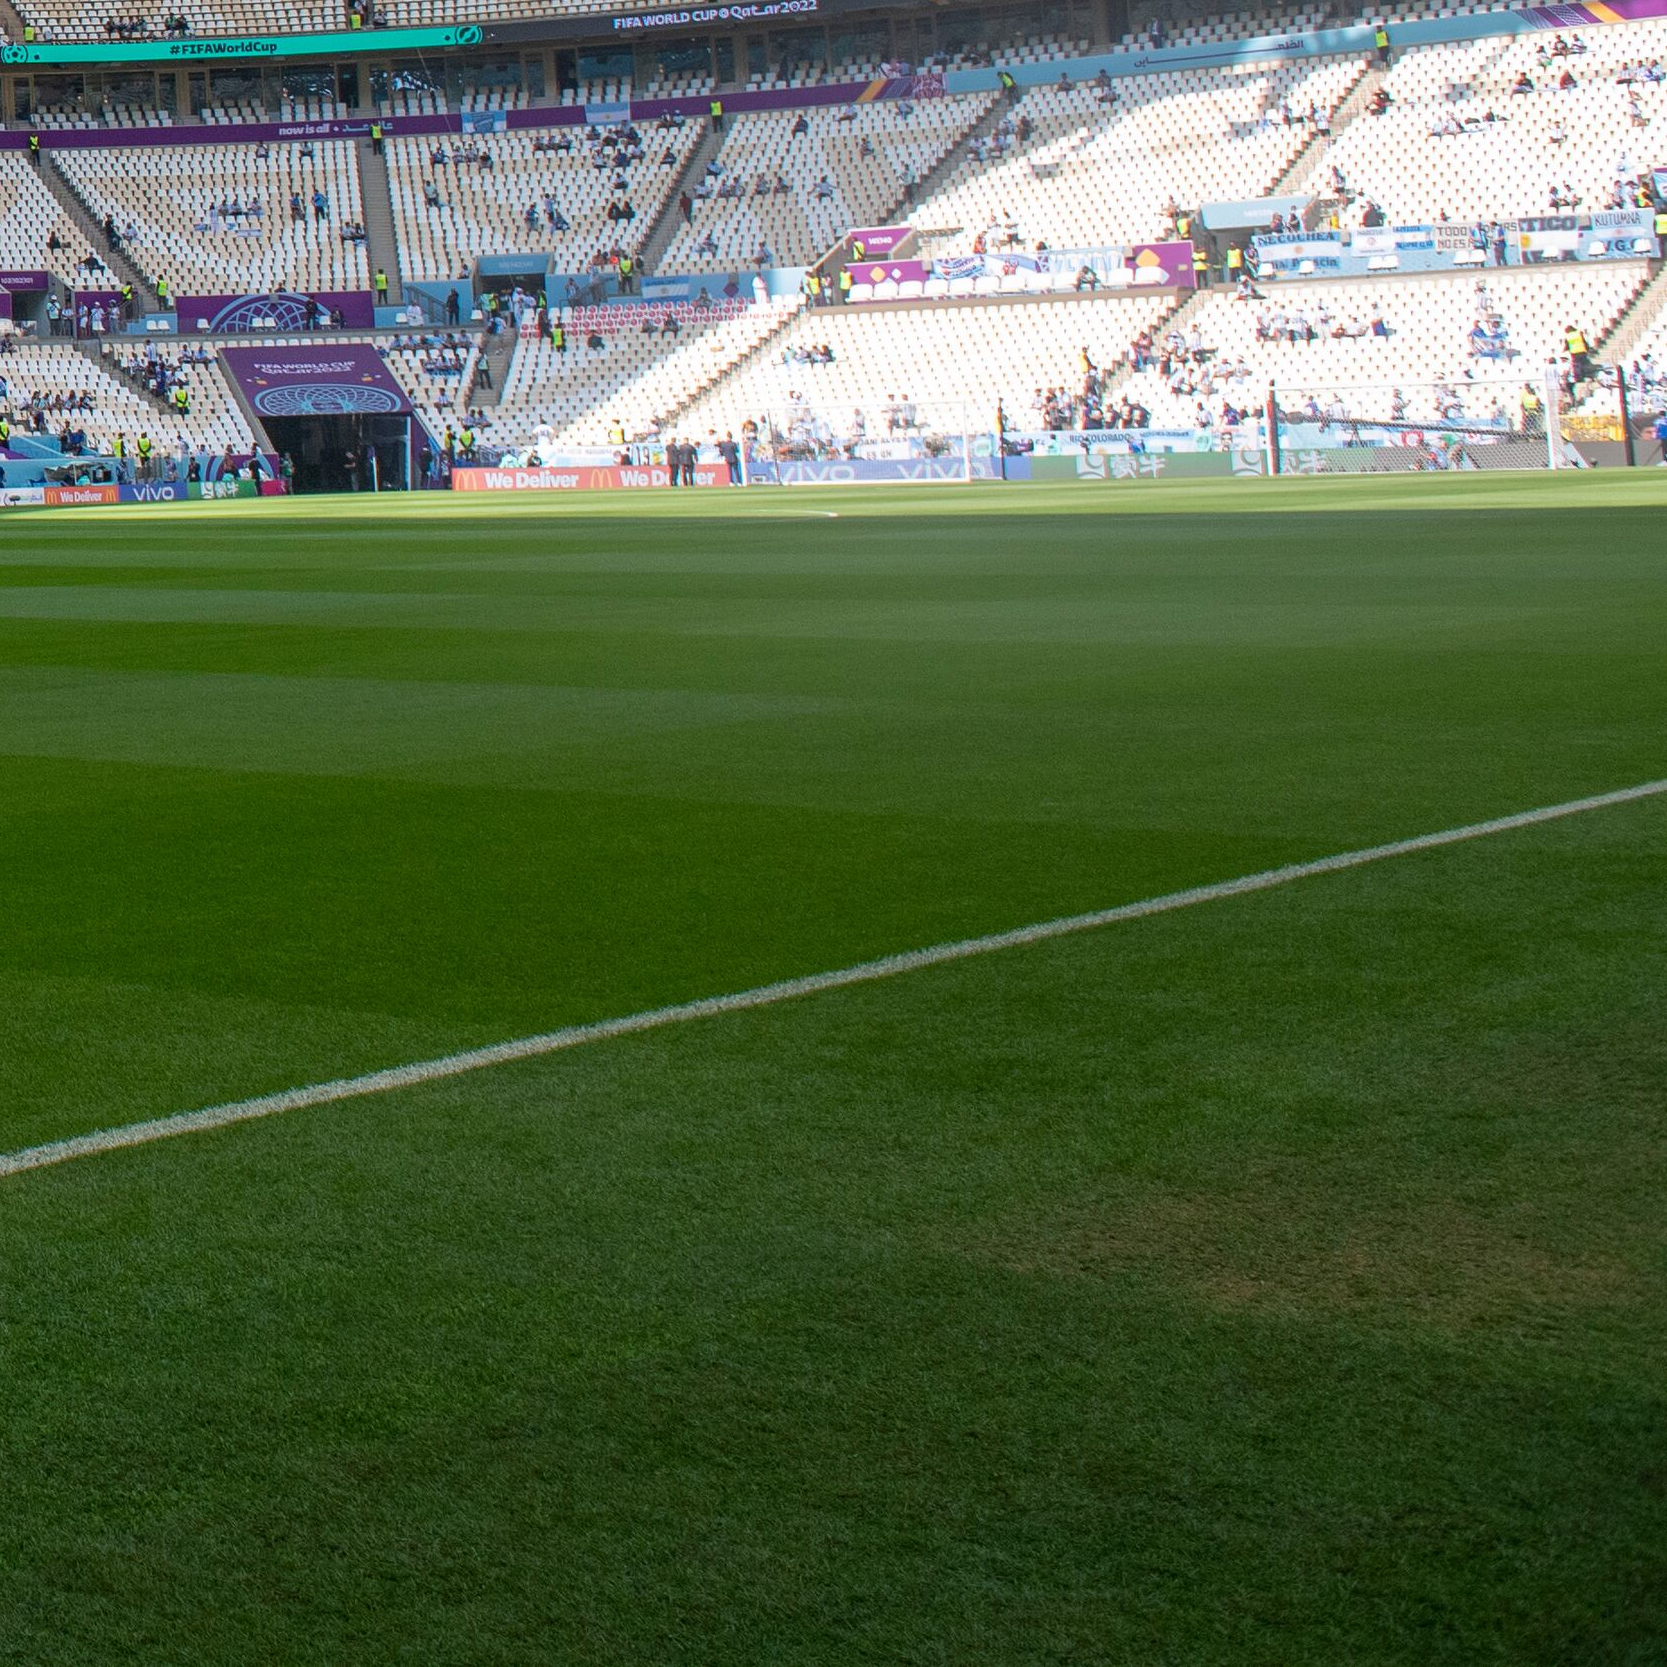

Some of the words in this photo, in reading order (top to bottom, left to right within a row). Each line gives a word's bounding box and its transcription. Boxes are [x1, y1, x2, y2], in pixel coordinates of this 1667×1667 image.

[613, 17, 642, 29] FIFA
[642, 12, 690, 26] WORLD
[692, 8, 717, 22] CUP
[170, 41, 278, 55] #FIFAWorldCup
[279, 127, 305, 136] now
[315, 123, 330, 133] all
[484, 472, 515, 488] We
[516, 471, 579, 488] Deliver
[620, 471, 653, 487] We
[60, 491, 74, 503] We
[74, 490, 103, 503] Deliver
[133, 484, 175, 502] vivo
